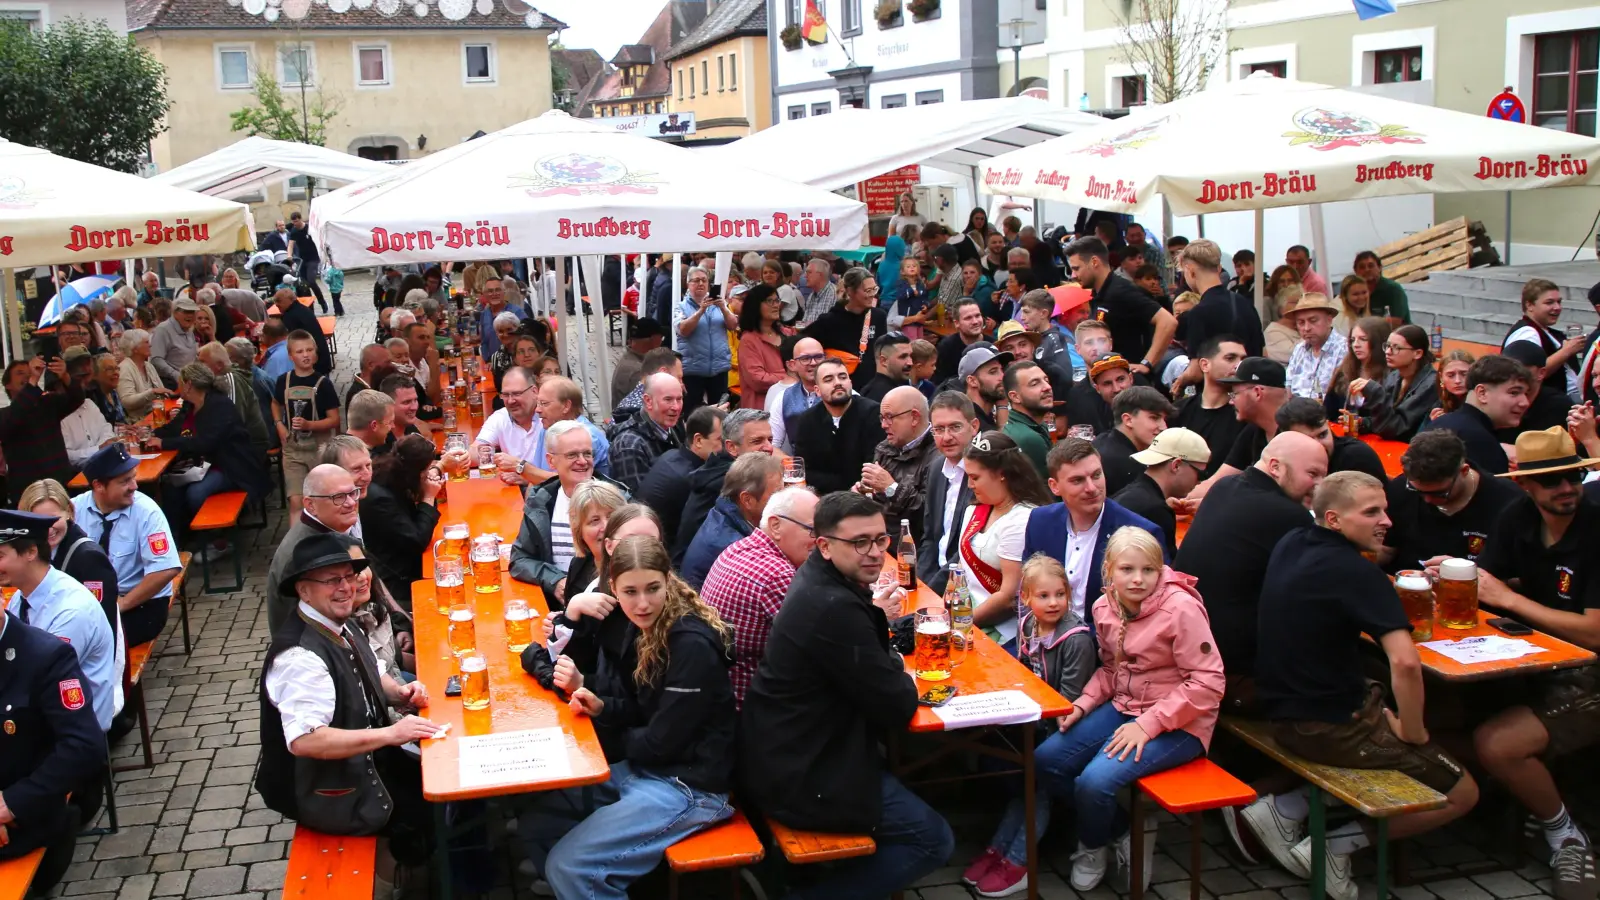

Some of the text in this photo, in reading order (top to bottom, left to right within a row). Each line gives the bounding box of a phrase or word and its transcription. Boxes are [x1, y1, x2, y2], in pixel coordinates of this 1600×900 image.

[1194, 160, 1436, 205] Dorn-Bräu Bruckberg
[1473, 153, 1588, 181] Dorn-Bräu
[1084, 175, 1138, 204] Dorn-Bräu
[65, 218, 210, 253] Dorn-Bräu
[366, 211, 831, 254] Dorn-Bräu Bruckberg Dorn-Bräu
